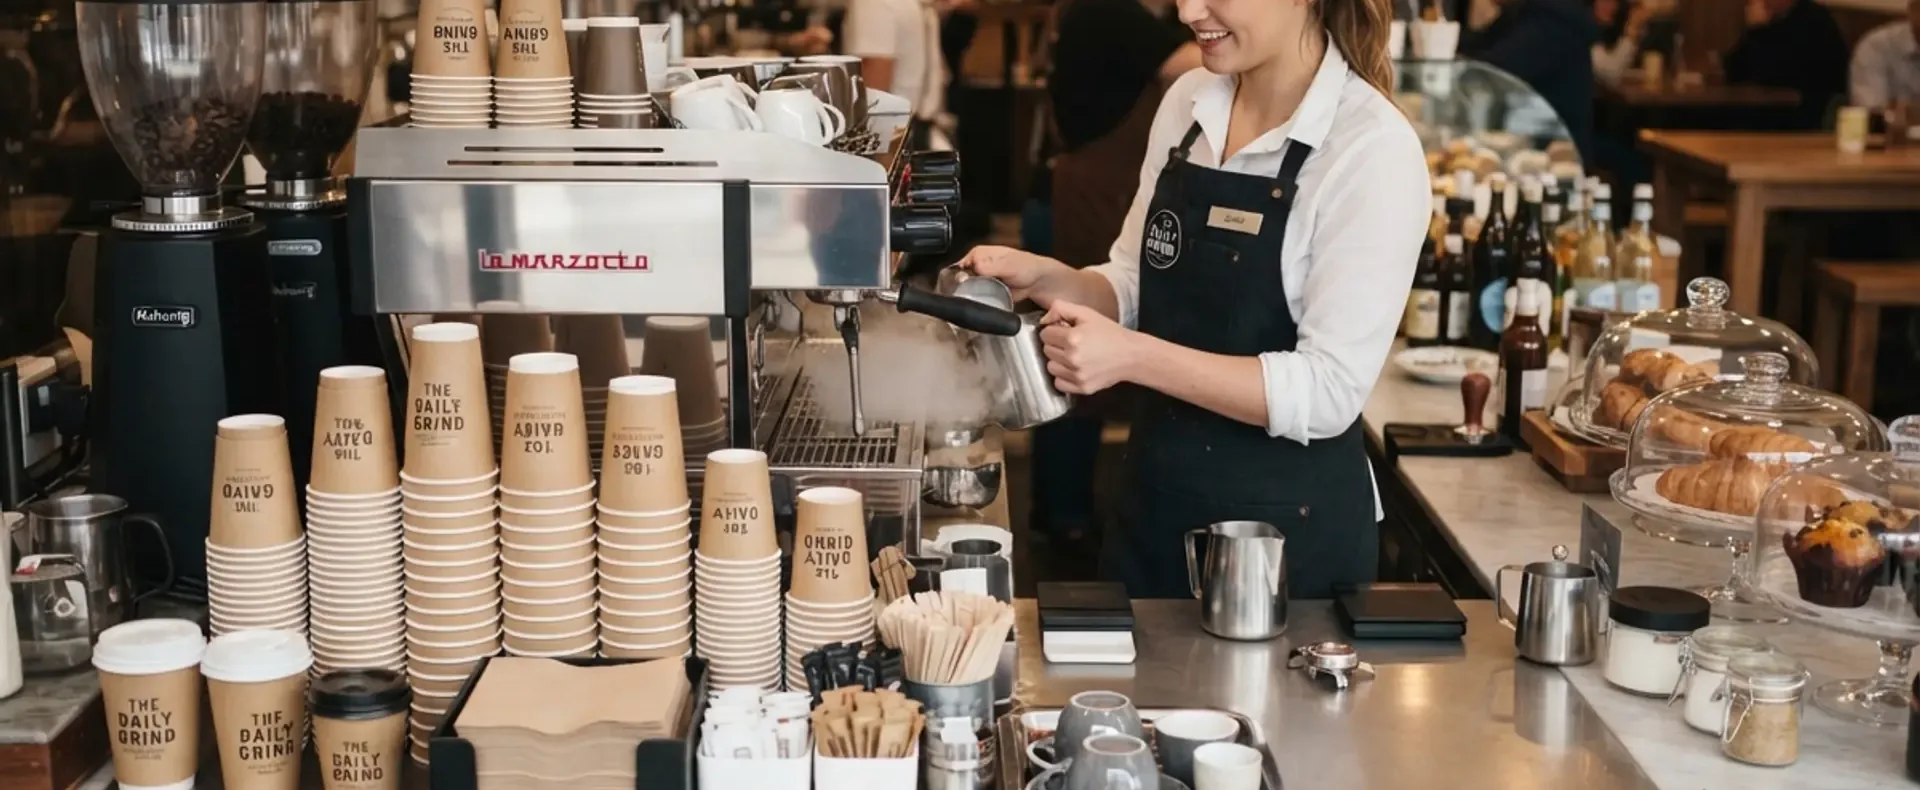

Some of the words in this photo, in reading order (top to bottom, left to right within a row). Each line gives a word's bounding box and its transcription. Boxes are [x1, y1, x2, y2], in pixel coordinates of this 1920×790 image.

[127, 697, 160, 714] THE
[118, 711, 173, 729] DAILY
[118, 728, 176, 746] GRIND
[239, 720, 294, 744] DAILY
